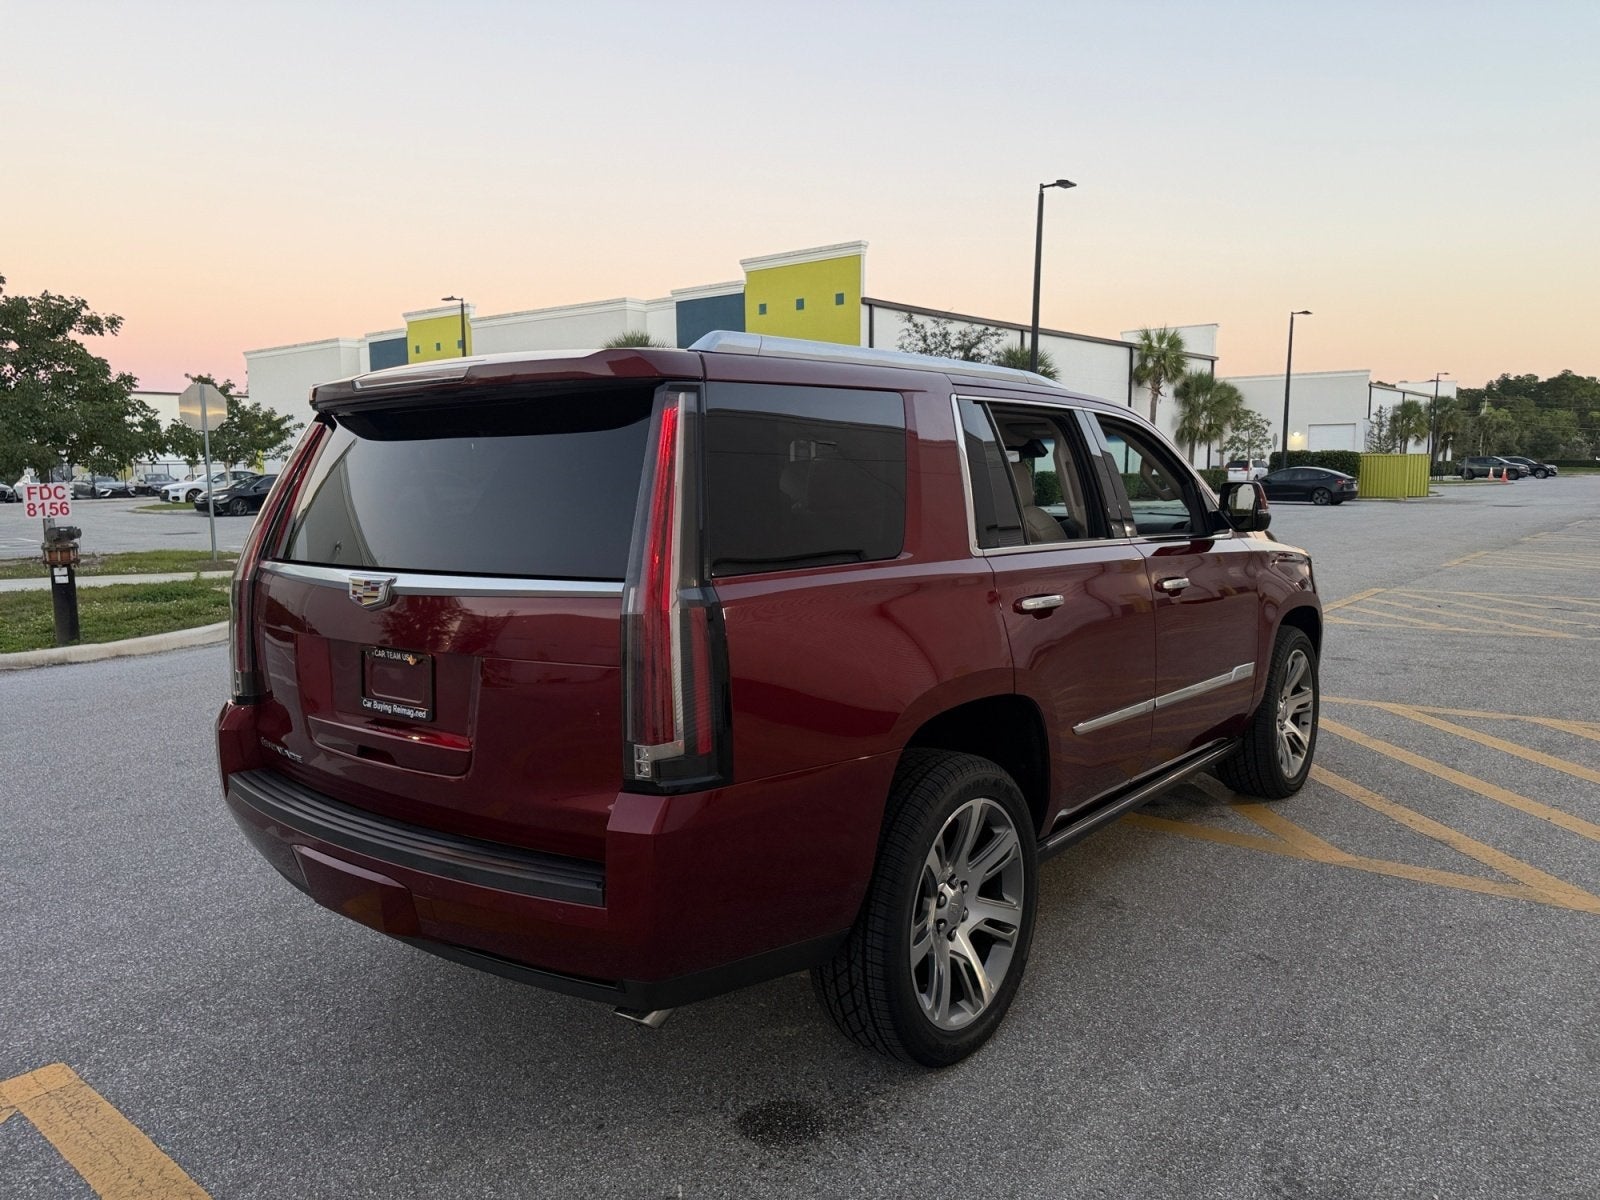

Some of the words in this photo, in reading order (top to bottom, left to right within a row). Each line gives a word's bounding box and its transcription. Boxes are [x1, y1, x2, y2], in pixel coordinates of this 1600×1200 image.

[26, 485, 66, 501] FDC
[26, 501, 70, 517] 8156
[374, 649, 386, 658] CAR
[386, 650, 401, 660] TEAM
[362, 699, 373, 708] Car
[373, 700, 392, 714] Buying
